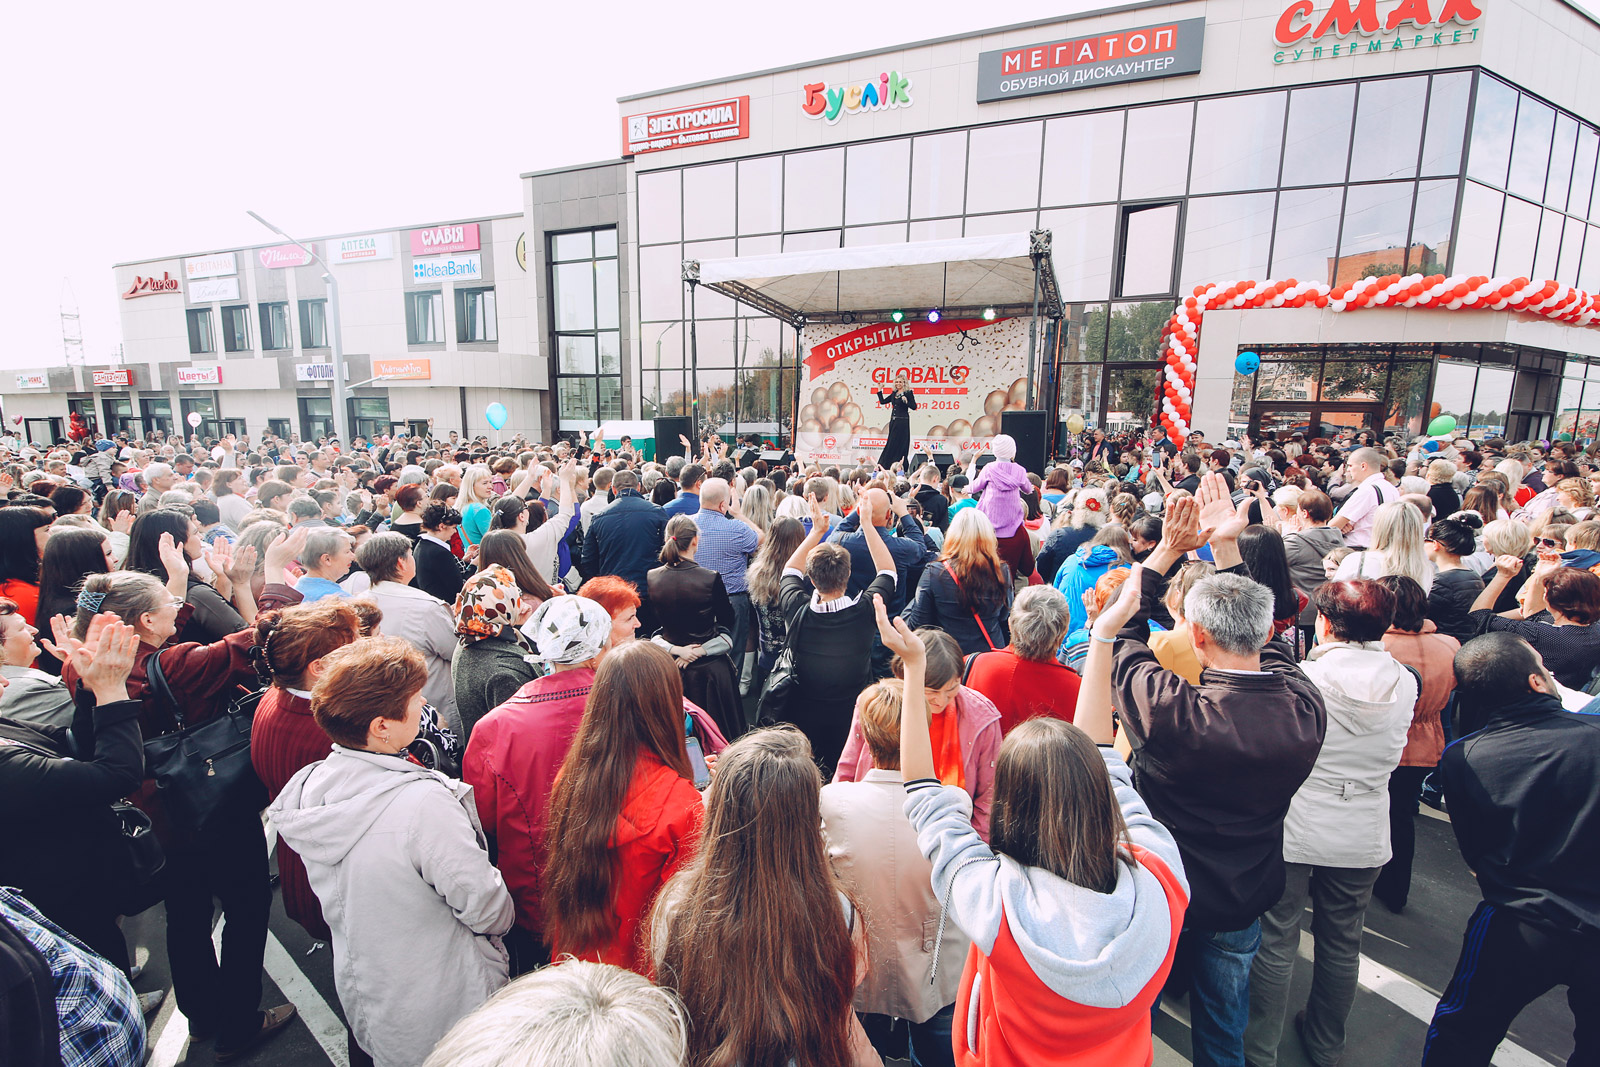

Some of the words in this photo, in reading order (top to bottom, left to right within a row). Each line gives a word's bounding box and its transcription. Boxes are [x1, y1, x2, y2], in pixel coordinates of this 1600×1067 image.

[1004, 29, 1172, 73] МЕГАТОП
[1273, 28, 1479, 63] СУПЕРМАРКЕТ
[1000, 69, 1069, 93] ОБУВНОЙ
[1072, 56, 1175, 84] ДИСКАУНТЕР
[649, 105, 734, 134] ЭЛЕКТРОСИЛА
[341, 238, 376, 252] АПТЕКА
[421, 226, 464, 246] СЛАВІЯ
[423, 259, 476, 278] IdeaBank
[826, 322, 913, 359] ОТКРЫТИЕ
[178, 371, 209, 382] Цветы
[871, 367, 949, 384] GLOBAL
[931, 400, 960, 410] 2016
[962, 441, 991, 450] СМА
